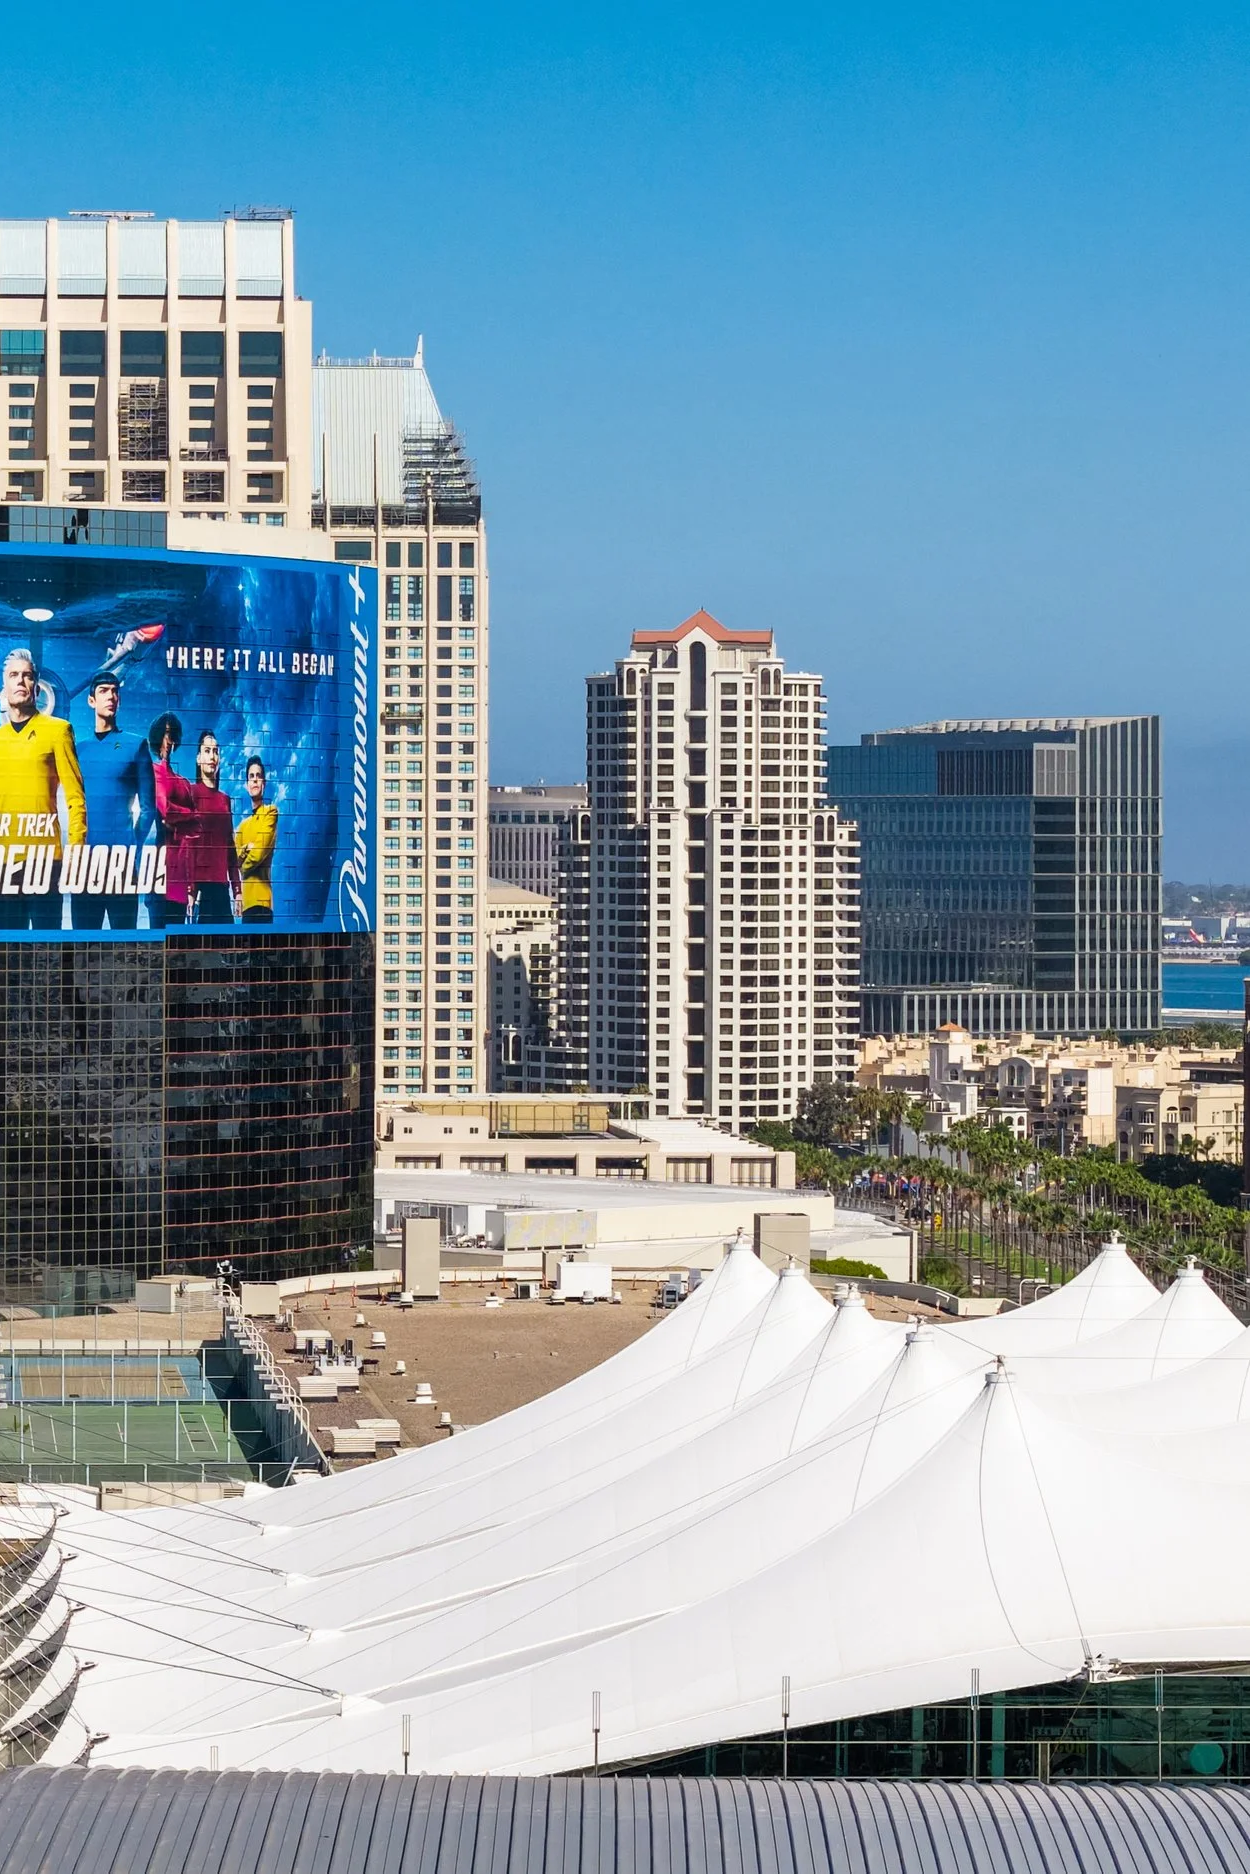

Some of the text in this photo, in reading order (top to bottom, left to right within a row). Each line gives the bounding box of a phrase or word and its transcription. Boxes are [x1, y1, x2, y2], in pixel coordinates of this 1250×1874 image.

[232, 648, 251, 672] IT
[257, 650, 286, 673] ALL
[291, 652, 335, 676] BEGAN
[17, 813, 58, 837] TREK
[58, 844, 167, 895] WORLDS
